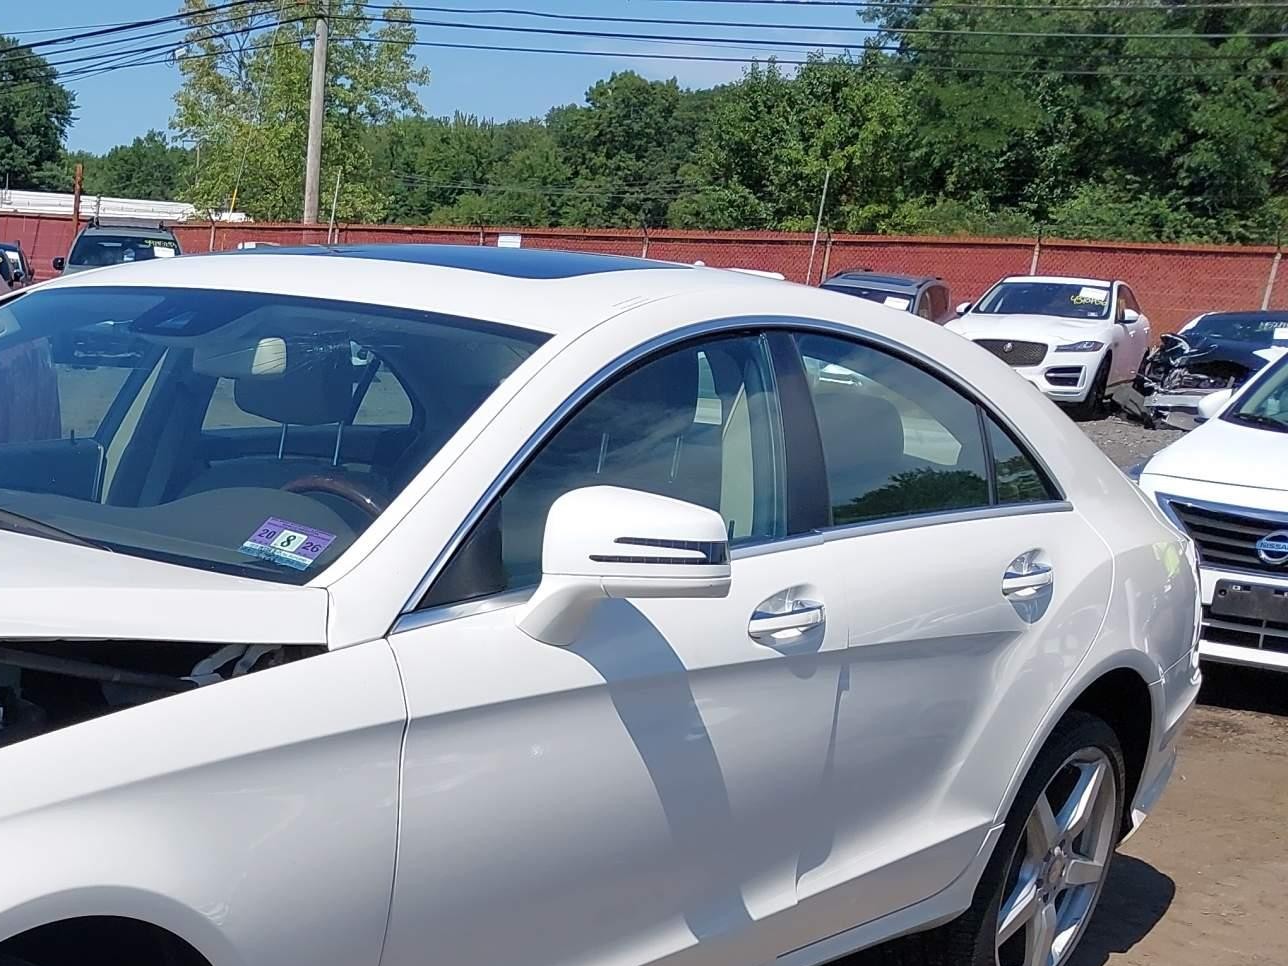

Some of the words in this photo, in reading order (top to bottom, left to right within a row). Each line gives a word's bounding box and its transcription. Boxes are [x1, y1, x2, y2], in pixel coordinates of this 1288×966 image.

[258, 528, 276, 540] 20
[280, 535, 297, 548] 8
[302, 541, 322, 553] 26
[1260, 541, 1288, 550] NISSA
